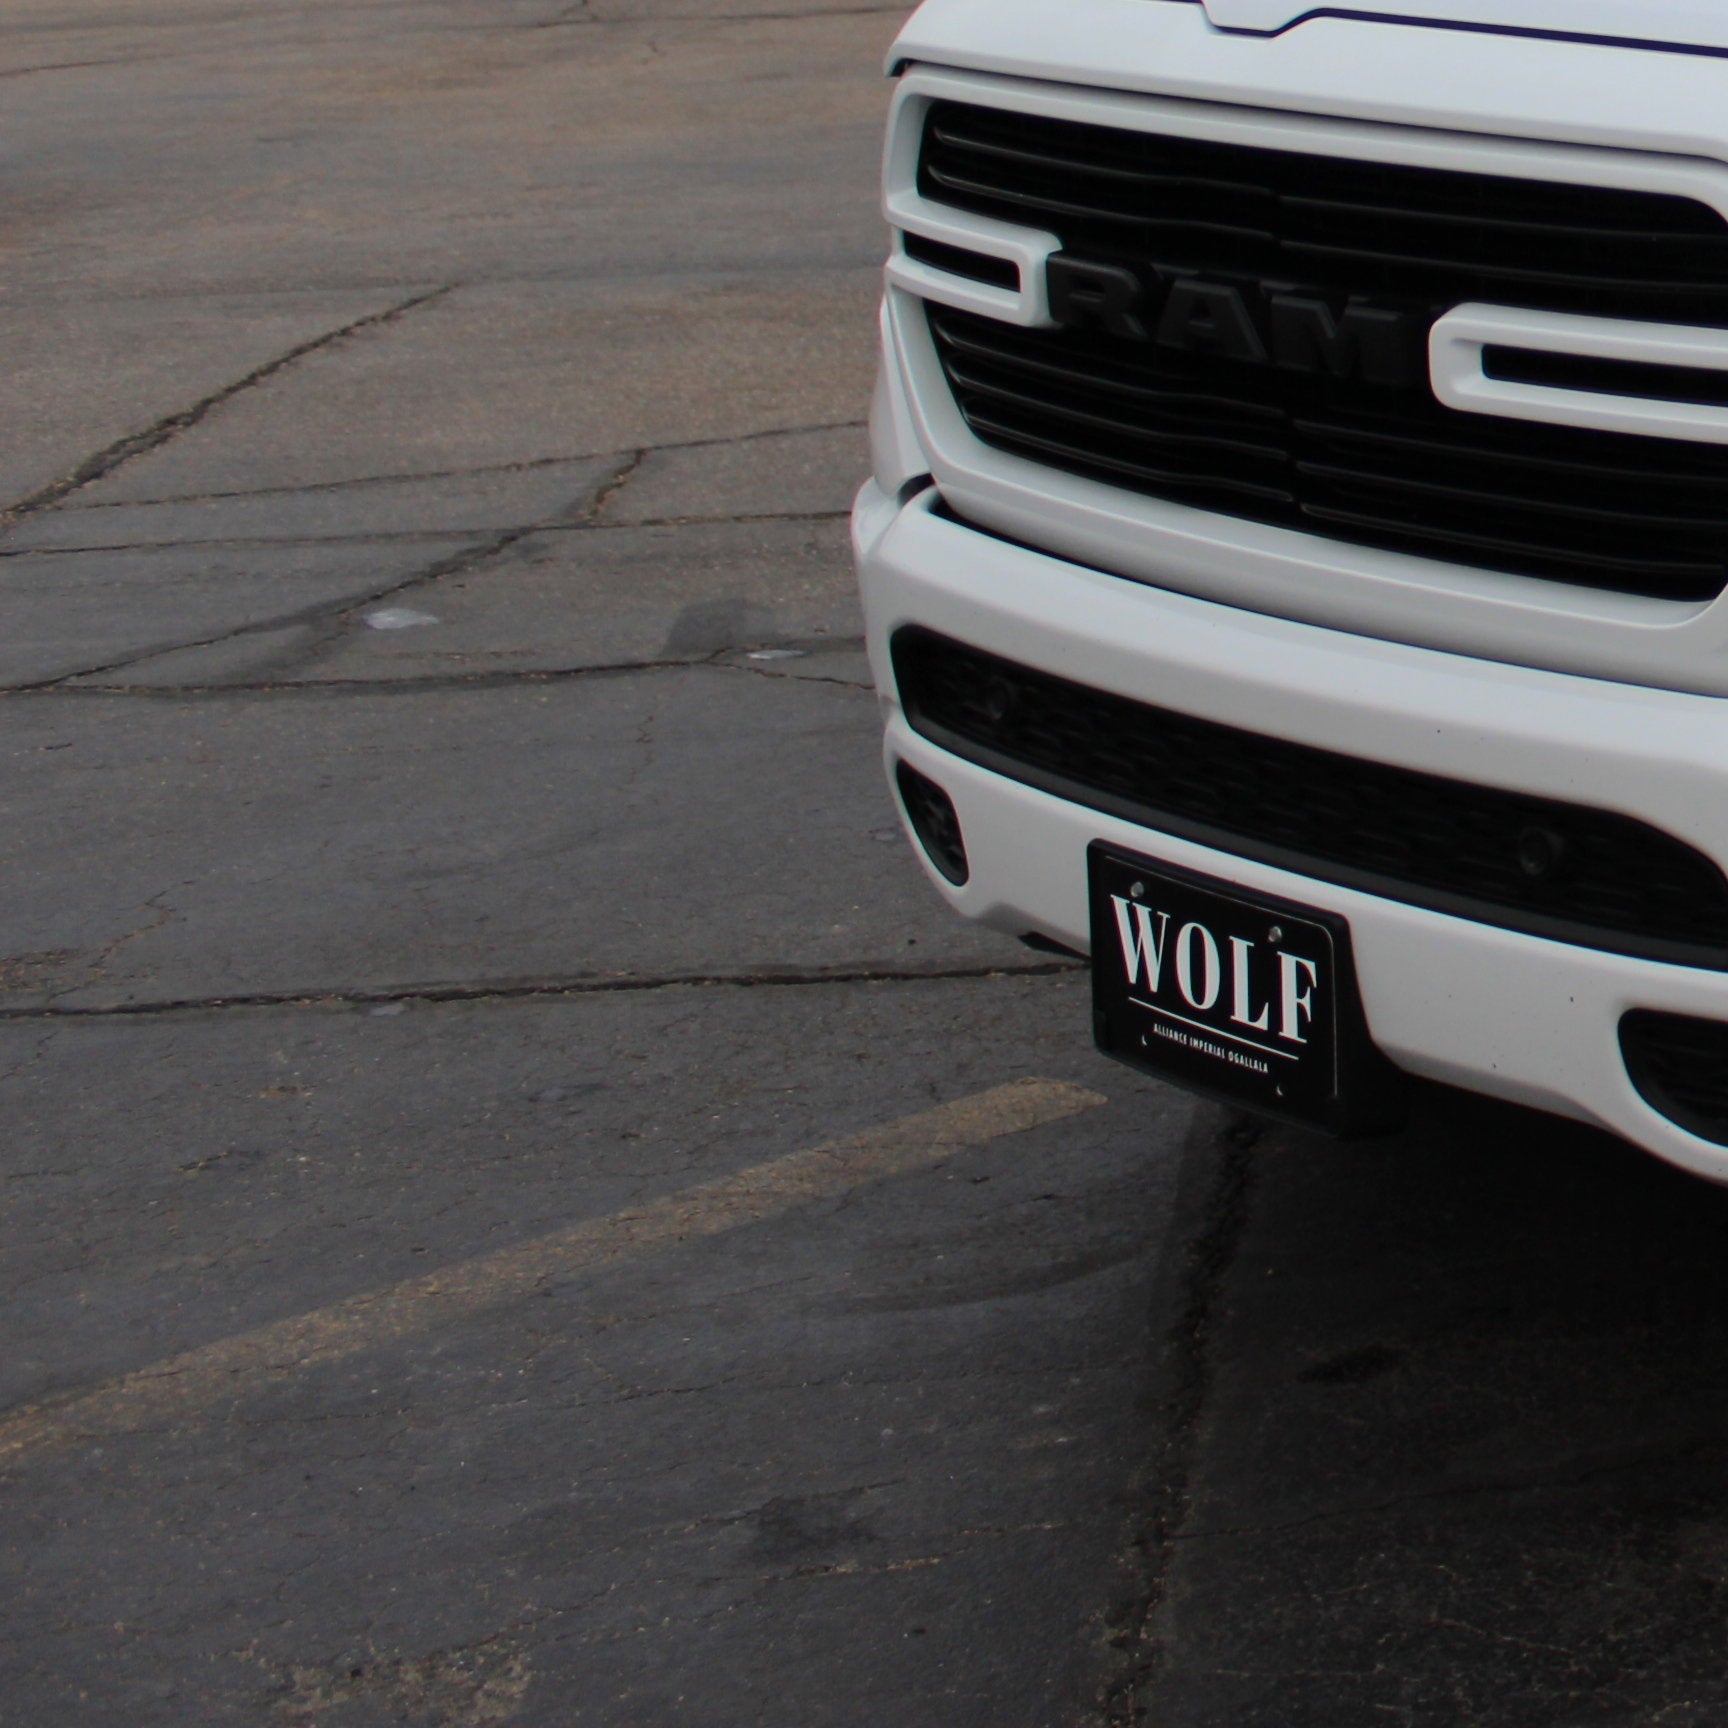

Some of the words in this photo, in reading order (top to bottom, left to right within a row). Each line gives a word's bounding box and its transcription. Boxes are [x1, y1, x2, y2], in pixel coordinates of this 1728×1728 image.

[1046, 252, 1404, 385] RAM
[1110, 894, 1318, 1044] WOLF
[1153, 1023, 1188, 1046] ALLIANCE
[1189, 1036, 1226, 1060] IMPERIAL
[1227, 1050, 1269, 1073] OGALLALA
